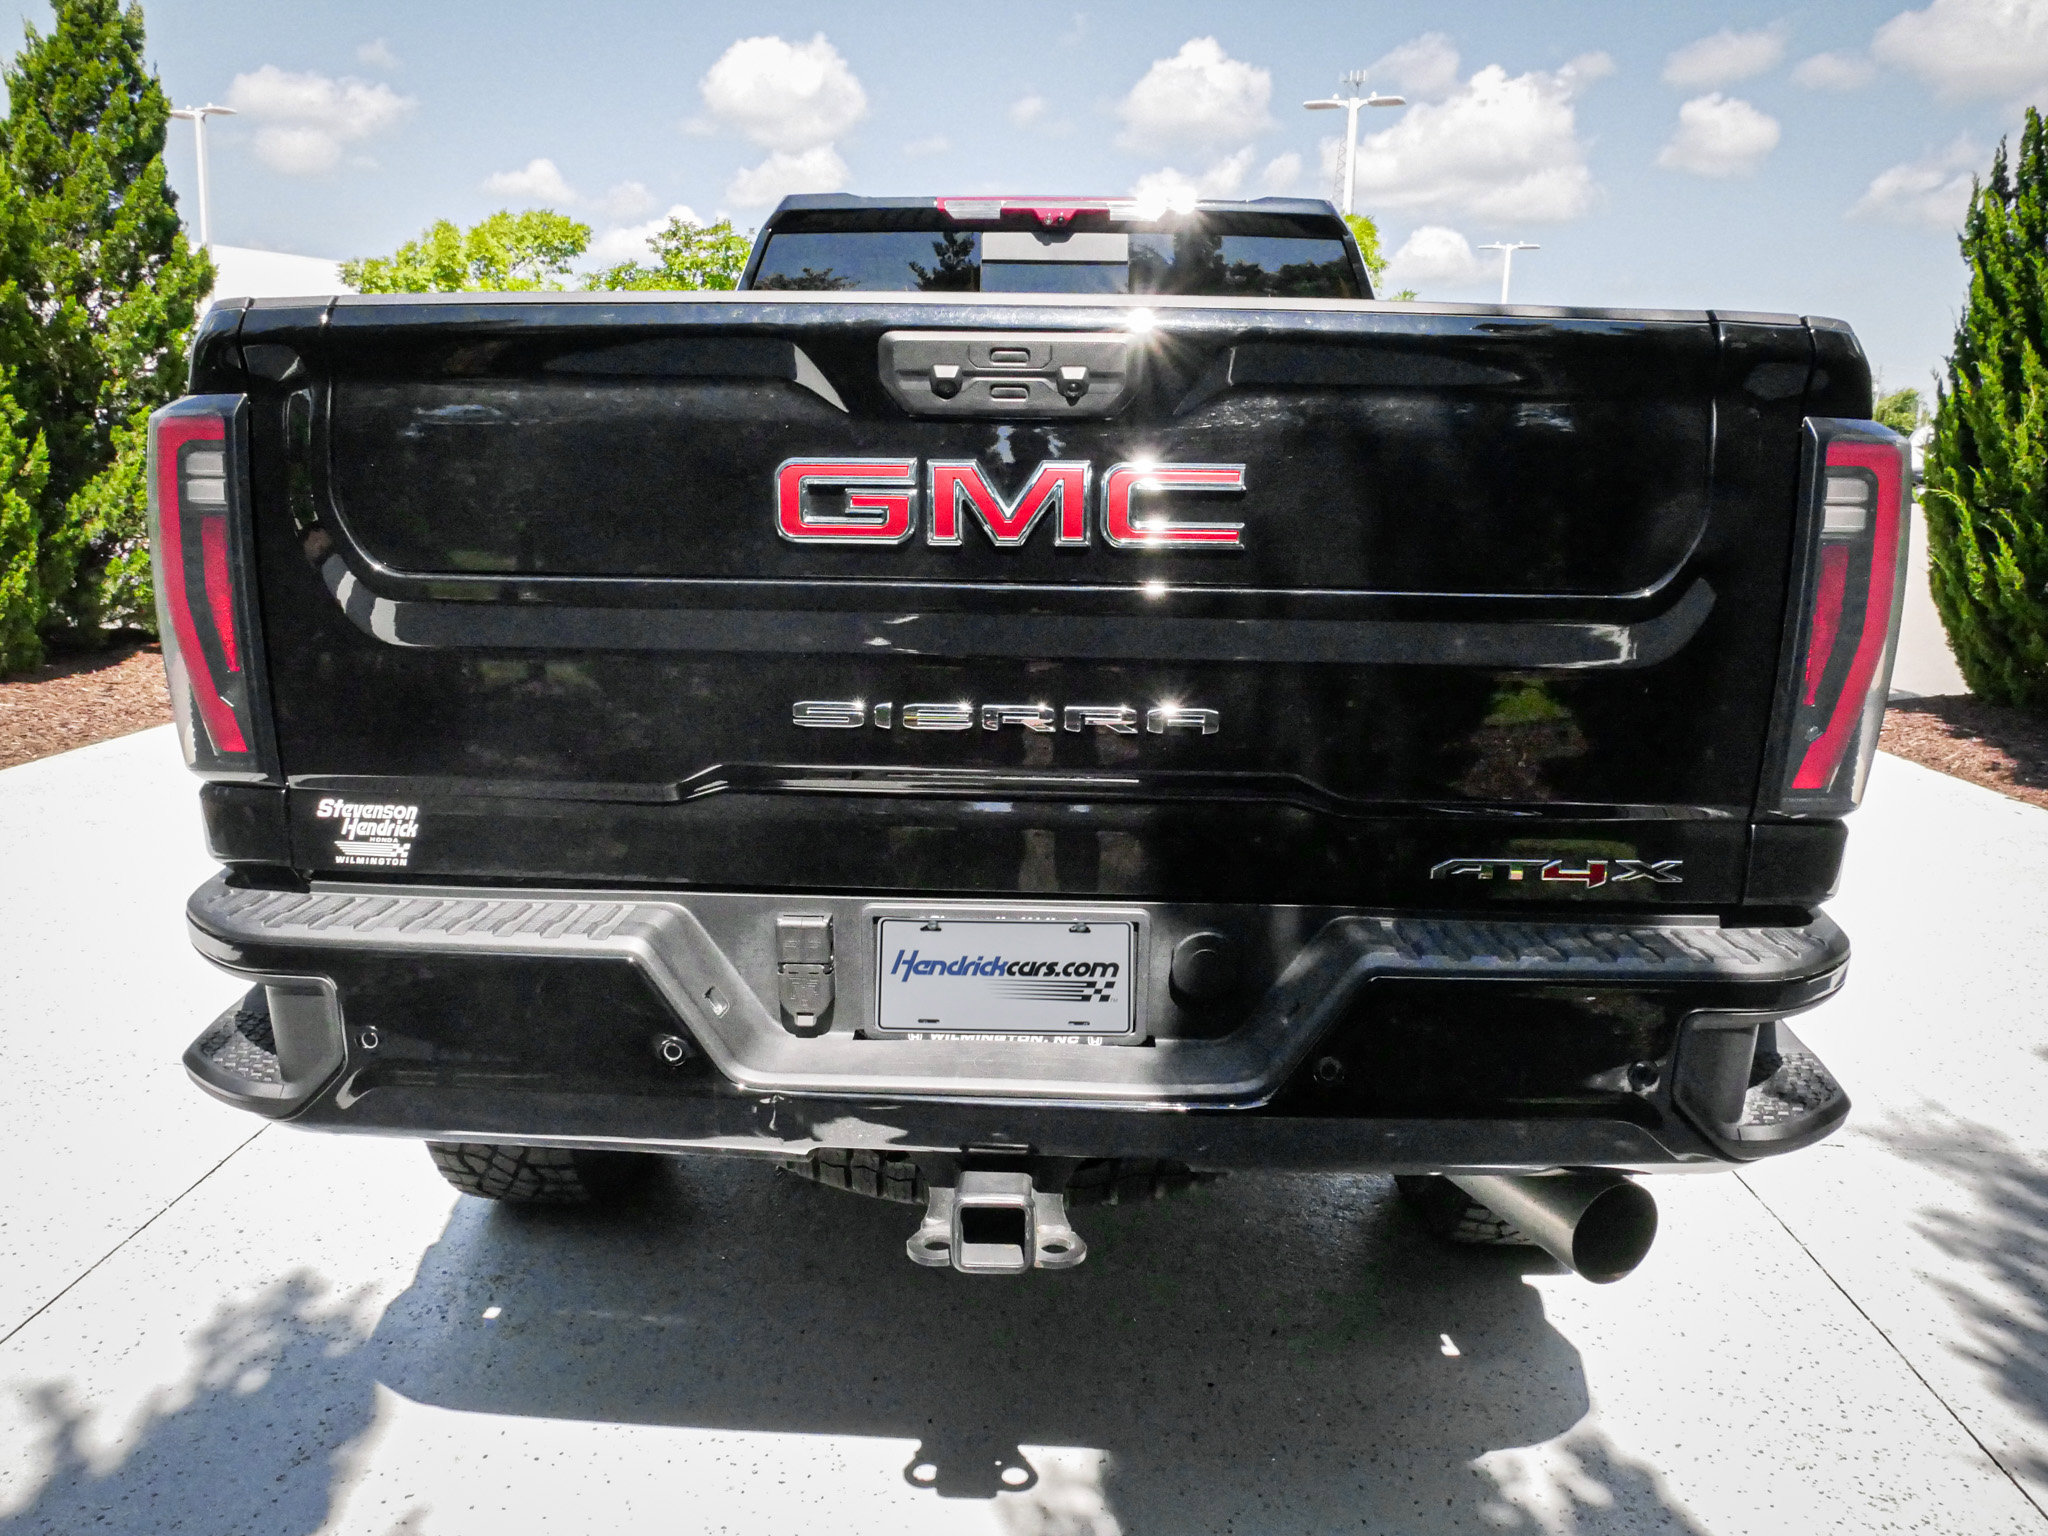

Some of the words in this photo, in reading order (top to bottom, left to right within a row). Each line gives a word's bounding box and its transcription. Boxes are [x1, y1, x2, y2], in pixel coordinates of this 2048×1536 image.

[775, 457, 1247, 549] GMC
[792, 701, 1220, 735] SIERRA
[316, 798, 419, 820] Stevenson
[341, 818, 419, 840] Hendrick
[335, 856, 407, 866] WILMINGTON
[1430, 859, 1683, 888] AT4X
[890, 949, 1120, 983] Hendrickcars.com
[1053, 1036, 1080, 1045] NC
